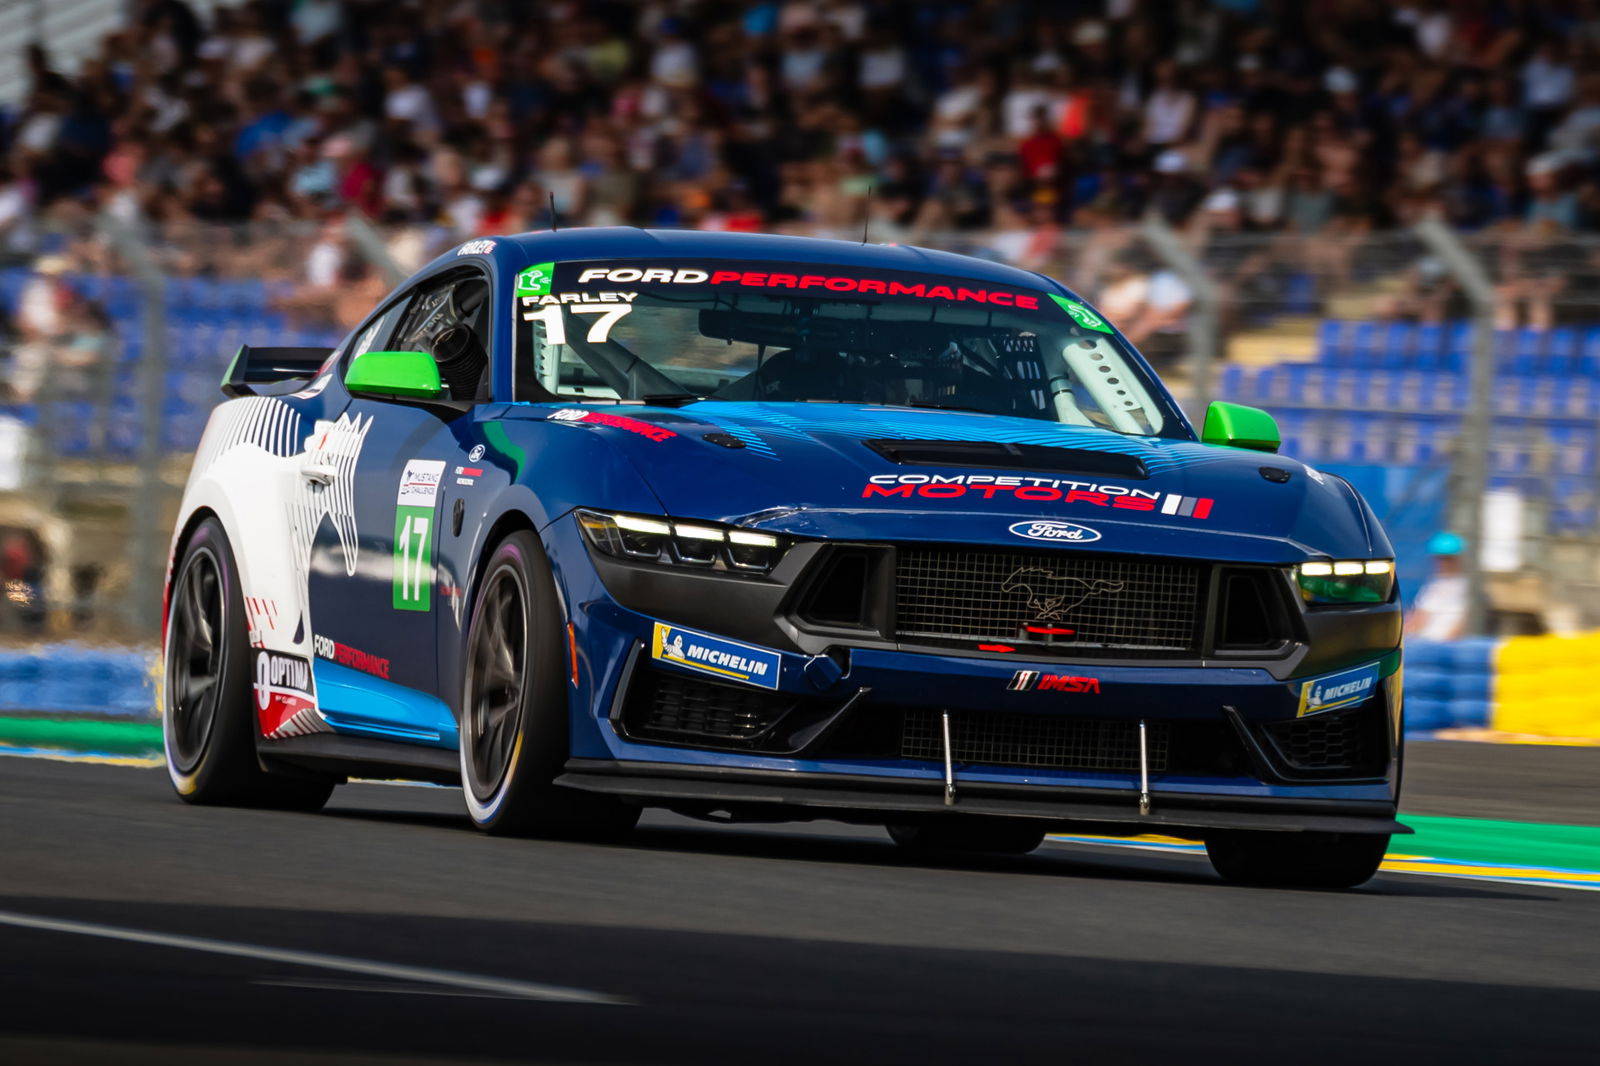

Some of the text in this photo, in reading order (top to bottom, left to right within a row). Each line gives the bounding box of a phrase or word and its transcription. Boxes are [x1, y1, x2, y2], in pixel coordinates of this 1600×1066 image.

[522, 292, 638, 306] FARLEY
[578, 269, 1039, 310] FORD PERFORMANCE
[523, 304, 632, 345] 17
[862, 484, 1157, 512] MOTORS
[869, 474, 1160, 501] COMPETITION
[1029, 521, 1083, 541] Ford
[399, 515, 429, 601] 17
[314, 634, 389, 679] FORD PERFORMANCE
[687, 645, 768, 676] MICHELIN
[1037, 674, 1100, 694] IMSA
[1322, 676, 1373, 700] MICHELIN
